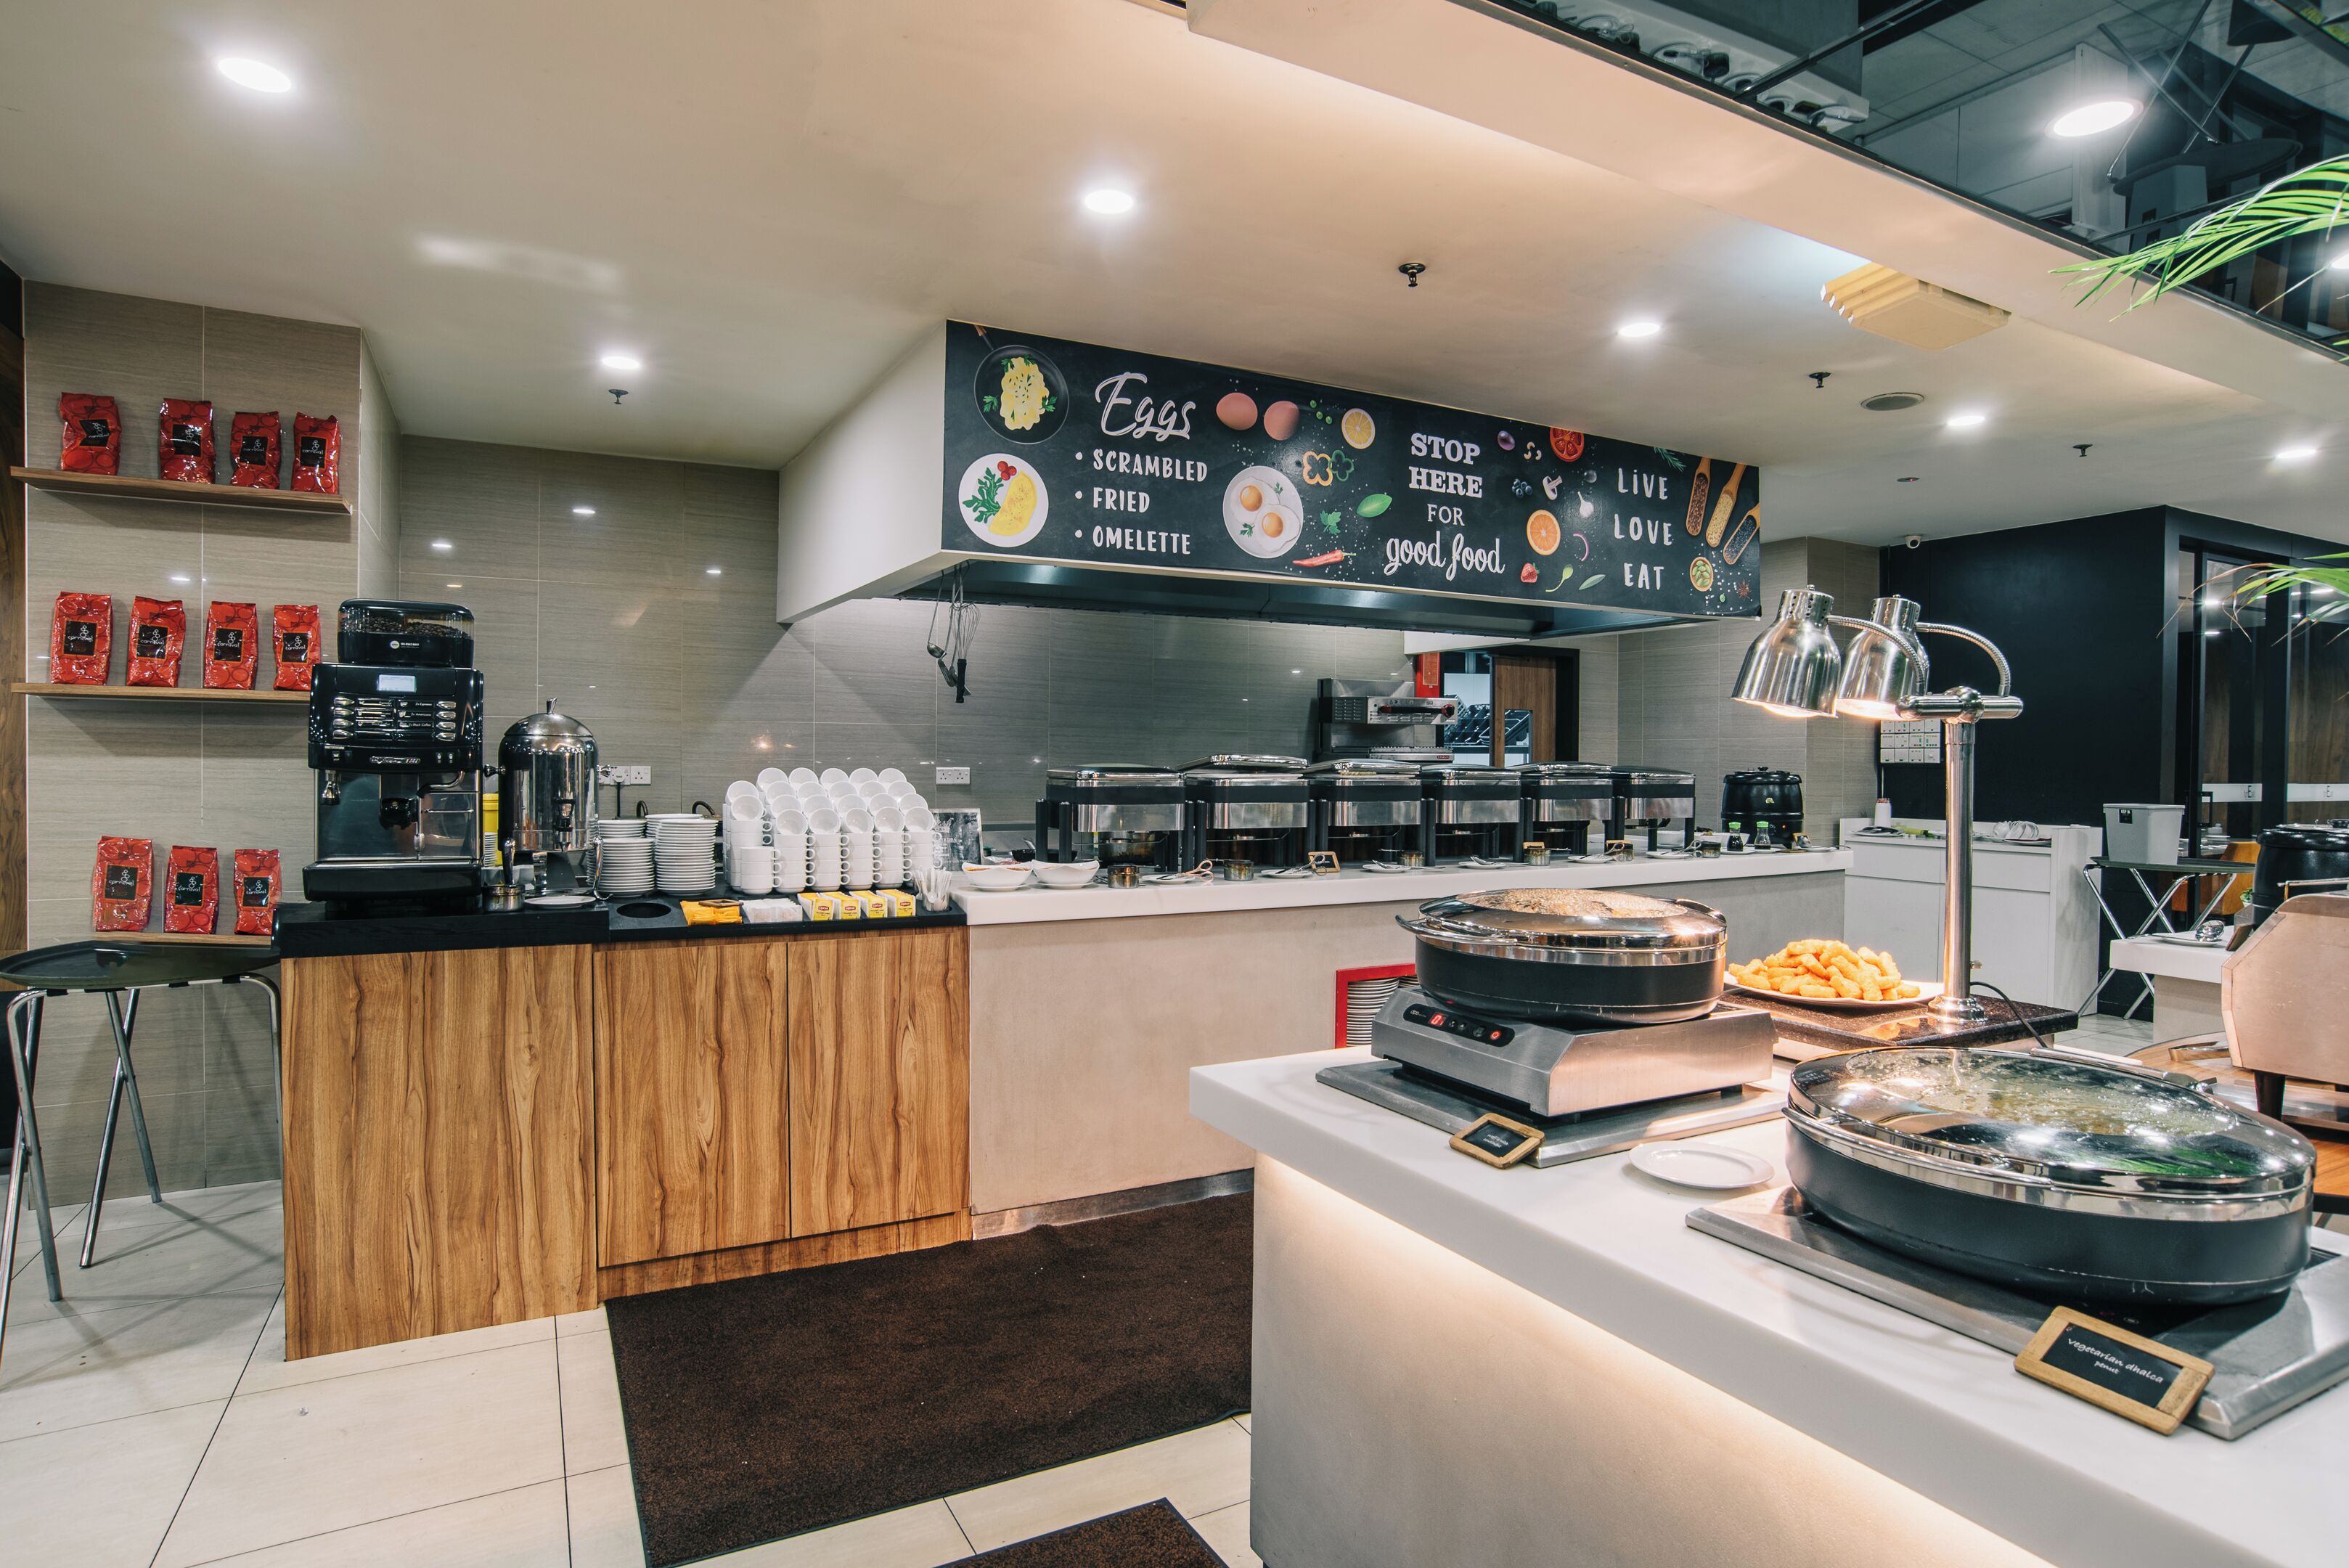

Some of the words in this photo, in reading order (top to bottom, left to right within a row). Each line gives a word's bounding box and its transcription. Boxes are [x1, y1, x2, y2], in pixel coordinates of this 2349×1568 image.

[1095, 371, 1197, 441] Eggs
[1410, 432, 1481, 465] STOP
[1092, 448, 1208, 483] SCRAMBLED
[1408, 465, 1483, 499] HERE
[1093, 486, 1151, 514] FRIED
[1426, 503, 1466, 527] FOR
[1092, 525, 1192, 555] OMELETTE
[1613, 513, 1673, 547] LOVE
[1384, 530, 1447, 576] good
[1445, 532, 1506, 581] food
[1624, 562, 1665, 591] EAT
[2067, 1338, 2124, 1367] vegetarian
